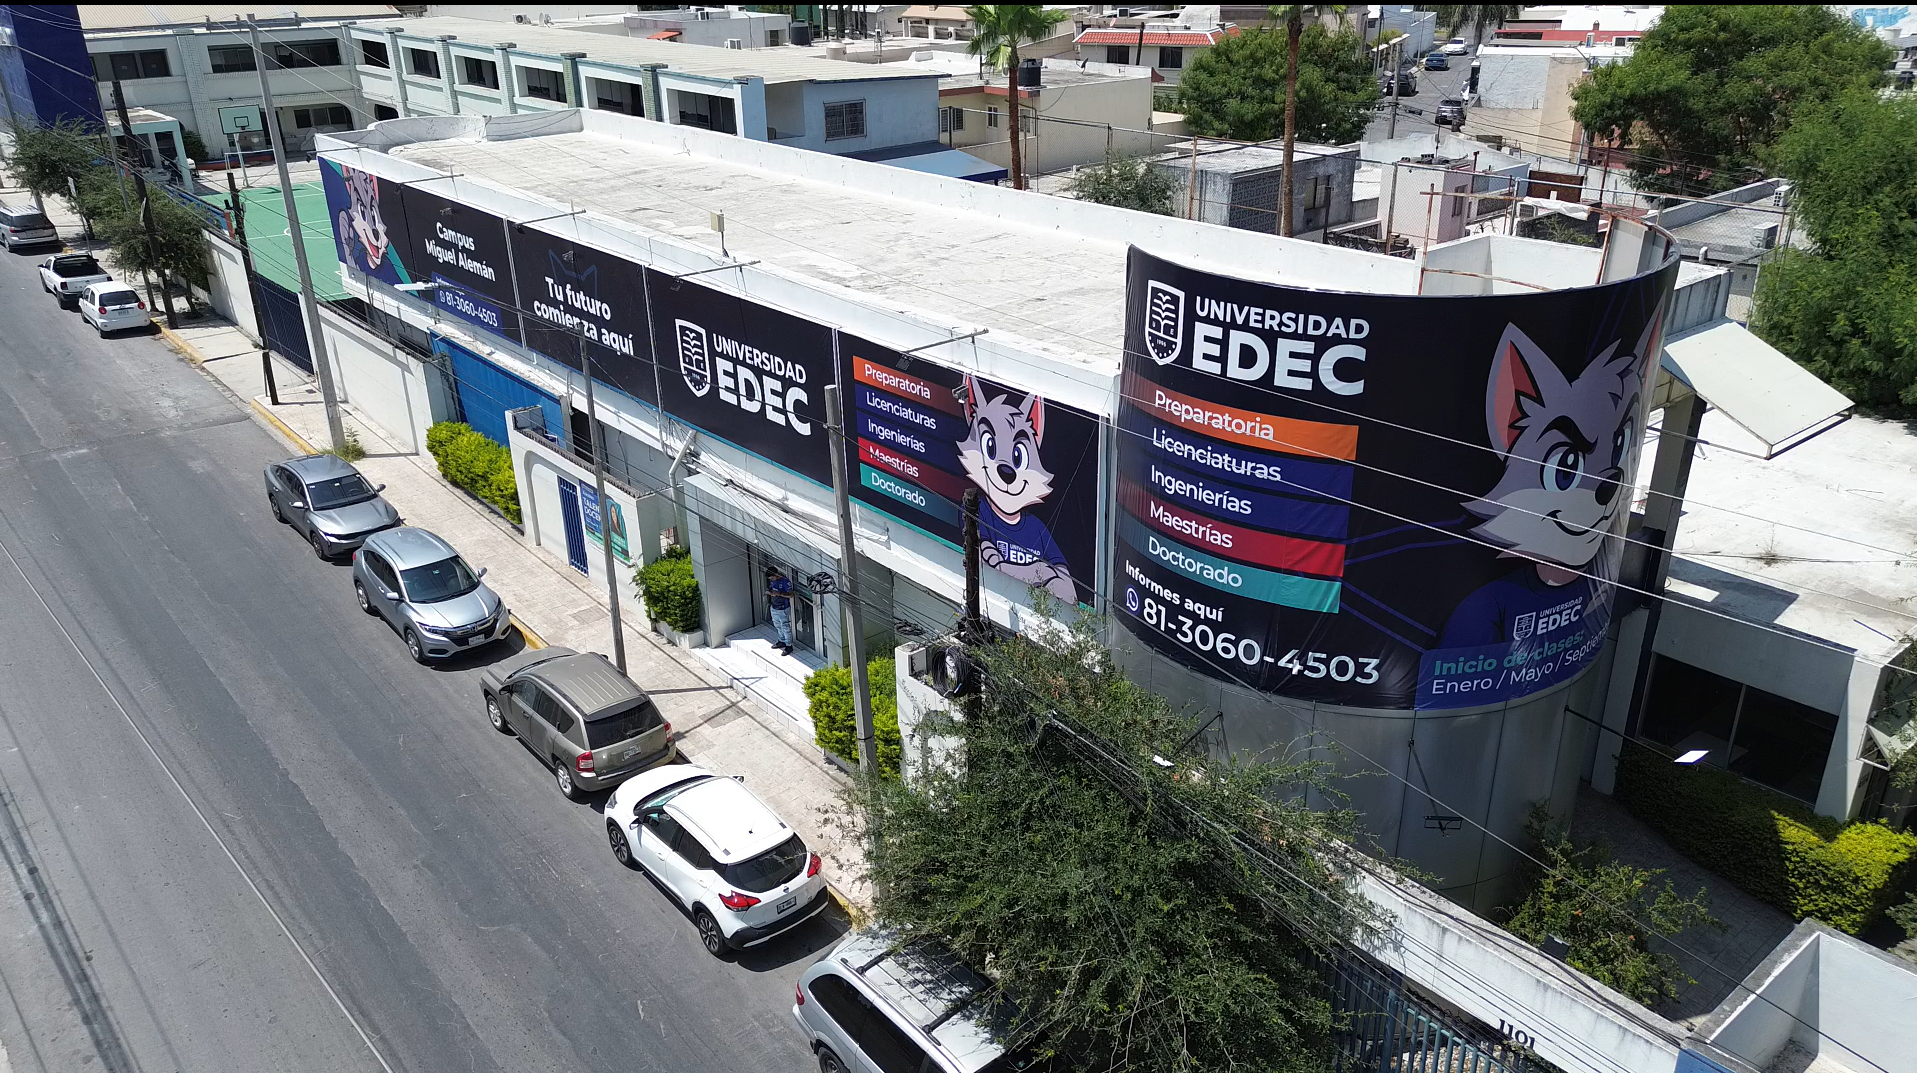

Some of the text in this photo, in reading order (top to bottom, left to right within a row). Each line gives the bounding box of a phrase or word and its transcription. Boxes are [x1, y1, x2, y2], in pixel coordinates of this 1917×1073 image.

[436, 221, 475, 251] Campus
[425, 238, 496, 282] Miguel Alemán
[445, 291, 498, 327] 81-3060-4503
[544, 276, 611, 321] Tu futuro
[1195, 295, 1370, 340] UNIVERSIDAD
[533, 300, 634, 356] comienza aquí
[712, 332, 807, 384] UNIVERSIDAD
[1192, 321, 1367, 396] EDEC
[715, 356, 812, 436] EDEC
[864, 363, 931, 400] Preparatoria
[866, 391, 937, 430] Licenciaturas
[1155, 389, 1275, 441] Preparatoria
[868, 418, 926, 453] Ingenierías
[1153, 427, 1282, 482] Licenciaturas
[869, 445, 919, 478] Maestrías
[871, 472, 926, 507] Doctorado
[1151, 464, 1252, 515] Ingenierías
[1150, 500, 1233, 549] Maestrías
[1148, 535, 1243, 588] Doctorado
[1125, 559, 1223, 622] Informes aquí
[1539, 596, 1583, 618] UNIVERSIDAD
[1143, 597, 1380, 685] 81-3060-4503
[1536, 604, 1582, 636] EDEC
[1432, 677, 1493, 695] Enero
[1496, 669, 1507, 690] /
[1510, 661, 1553, 685] Mayo
[1554, 652, 1564, 672] /
[1434, 629, 1585, 676] Inicio de clases:
[1499, 1018, 1535, 1051] 1101
